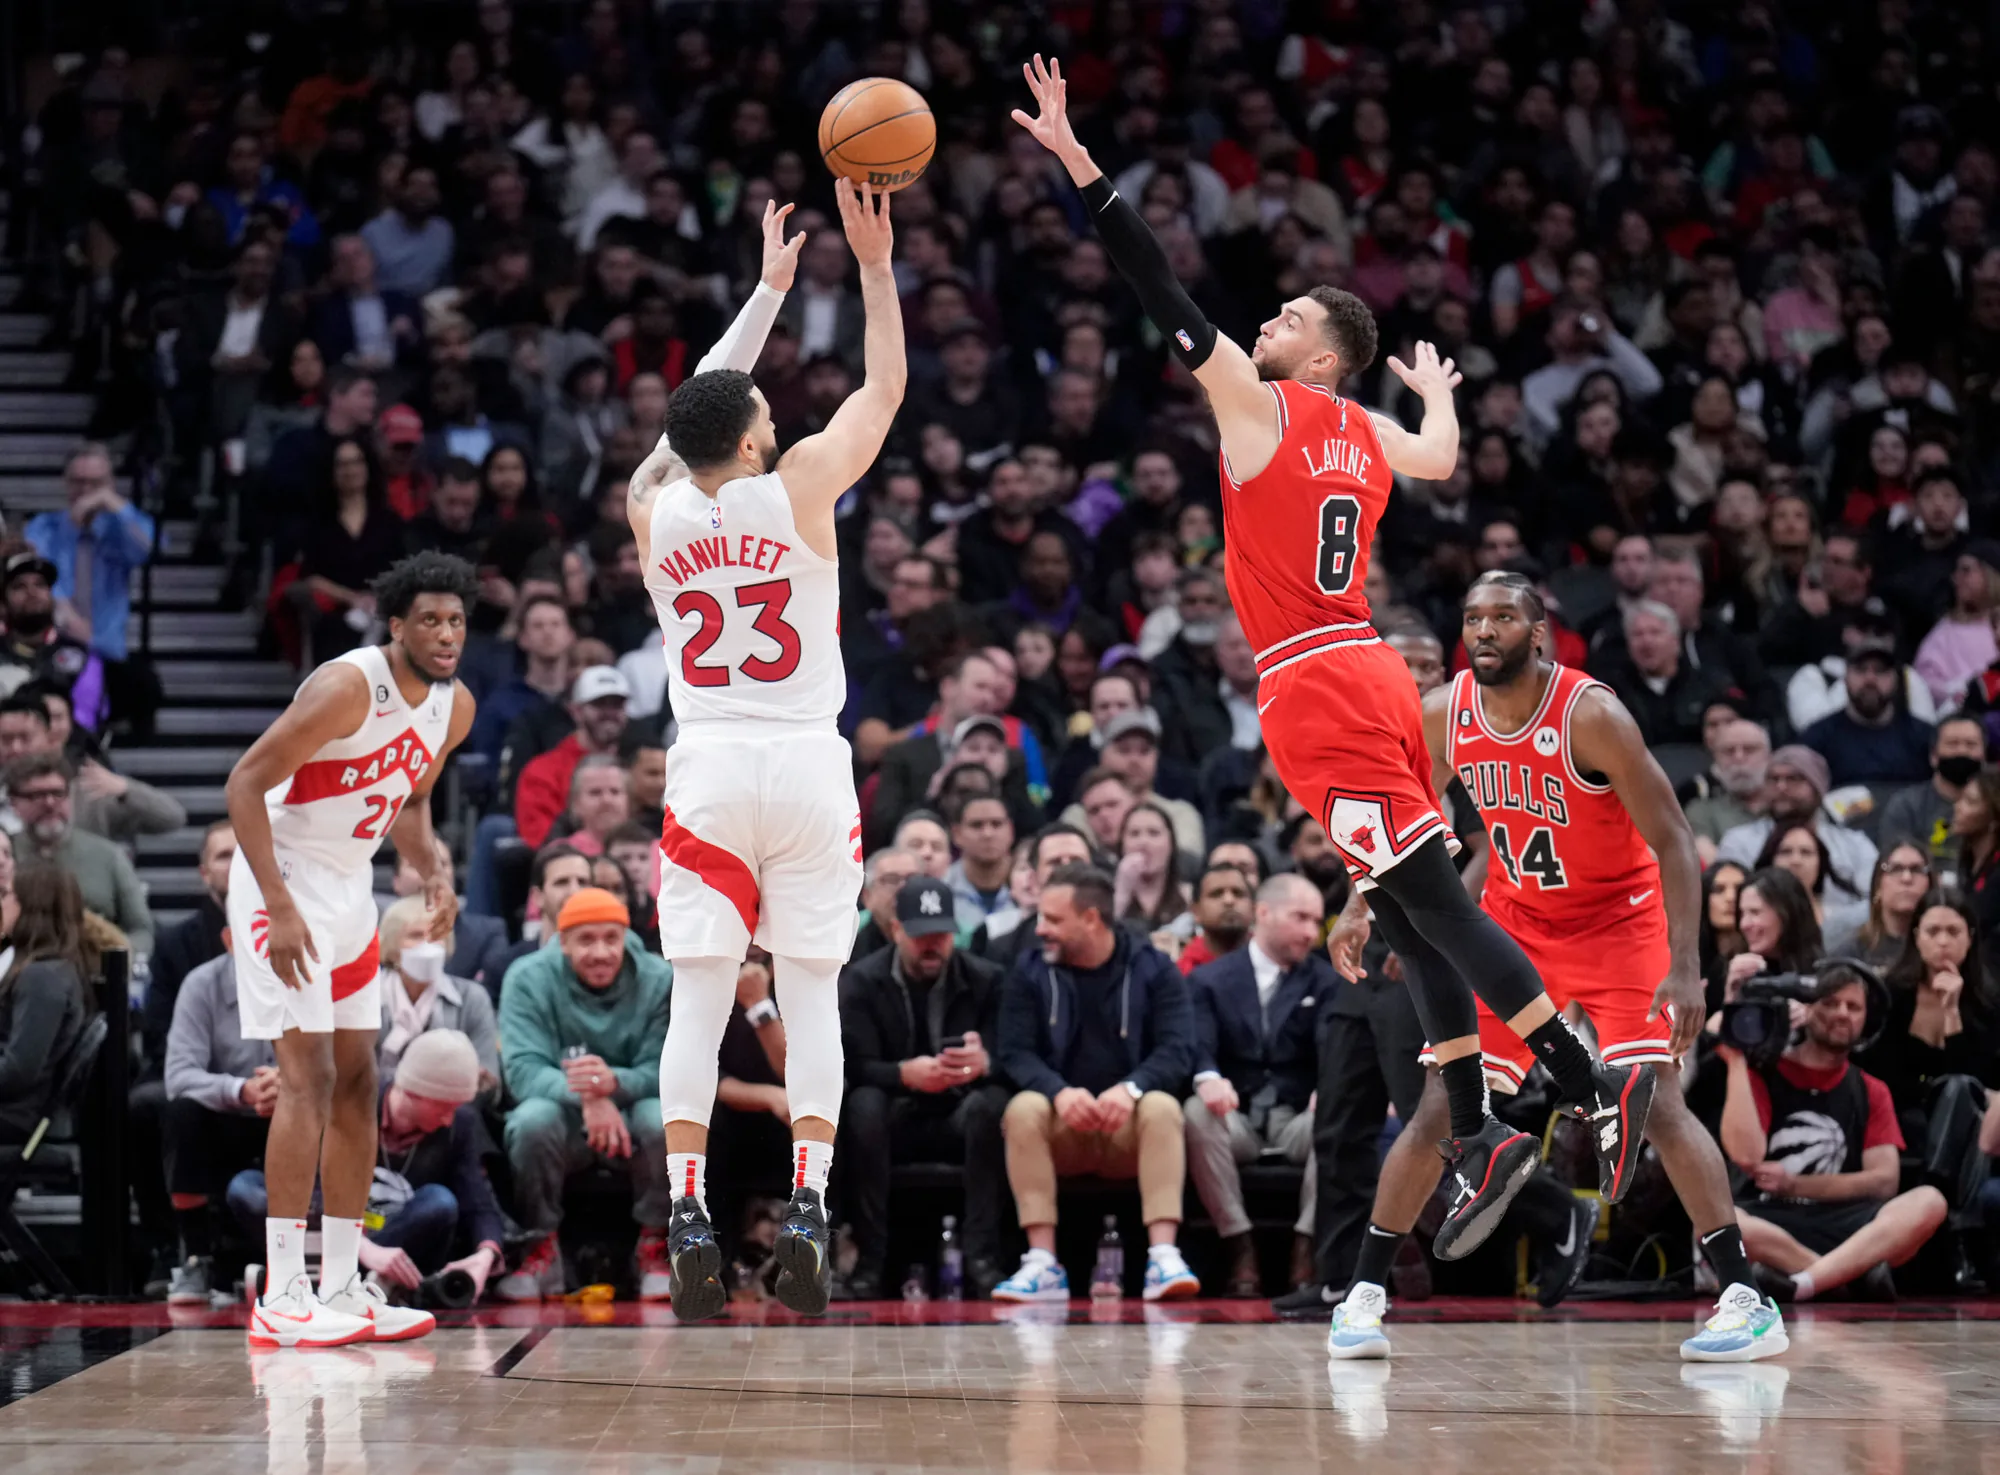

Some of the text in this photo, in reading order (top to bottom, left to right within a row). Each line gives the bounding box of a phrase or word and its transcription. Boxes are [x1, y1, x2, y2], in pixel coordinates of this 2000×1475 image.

[1302, 438, 1371, 485] LAVINE
[658, 534, 791, 586] VANVLEET
[1315, 494, 1362, 596] 8
[672, 577, 802, 687] 23
[376, 686, 387, 702] 6
[1460, 709, 1471, 726] 6
[352, 794, 405, 840] 21
[1458, 761, 1570, 827] BULLS
[1490, 822, 1568, 891] 44
